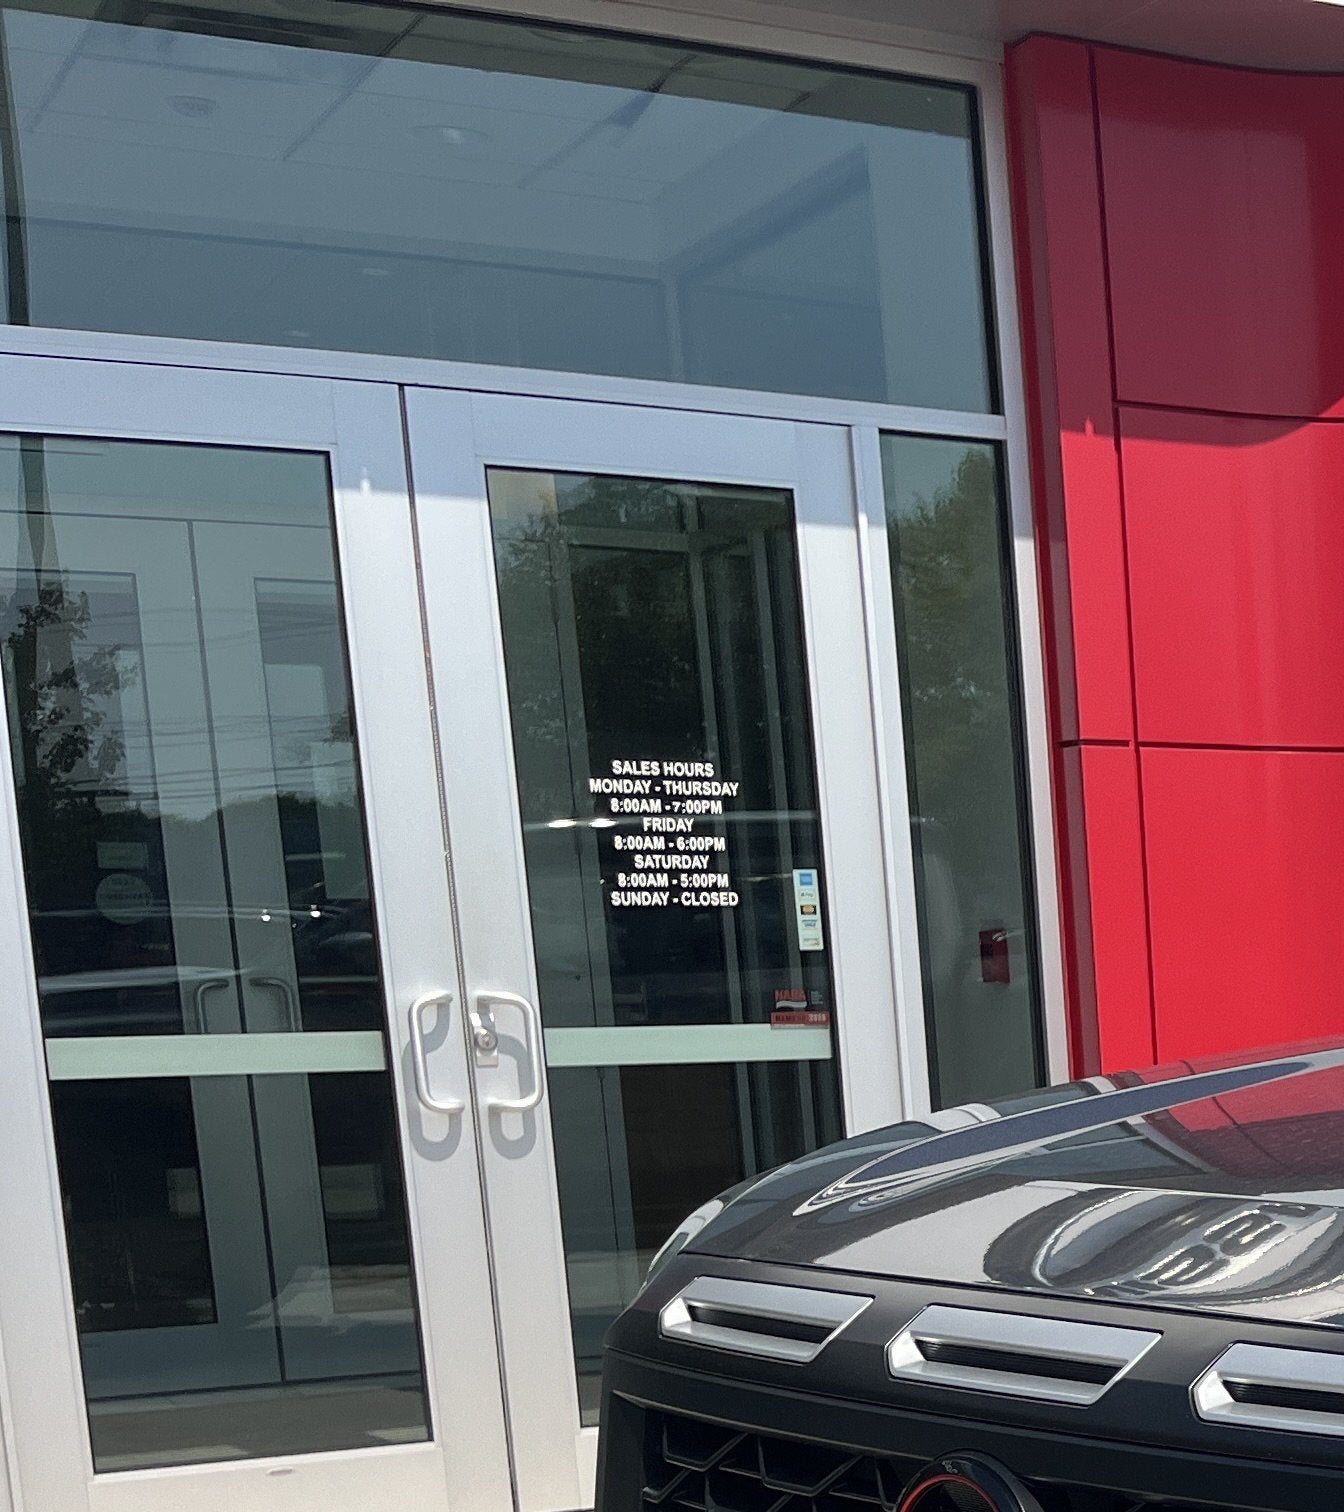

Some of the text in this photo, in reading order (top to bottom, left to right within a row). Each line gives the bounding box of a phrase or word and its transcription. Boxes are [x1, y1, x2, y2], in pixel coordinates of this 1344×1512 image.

[611, 759, 714, 777] SALES HOURS
[588, 778, 652, 794] MONDAY
[663, 780, 739, 796] THURSDAY
[610, 797, 662, 813] 8:00AM
[672, 799, 723, 814] 7:00PM
[643, 817, 694, 832] FRIDAY
[614, 835, 665, 851] 8:00AM
[676, 836, 725, 851] 6:00PM
[634, 854, 710, 870] SATURDAY
[617, 872, 669, 888] 8:00AM
[680, 873, 729, 888] 5:00PM
[611, 891, 669, 907] SUNDAY
[681, 891, 739, 907] CLOSED
